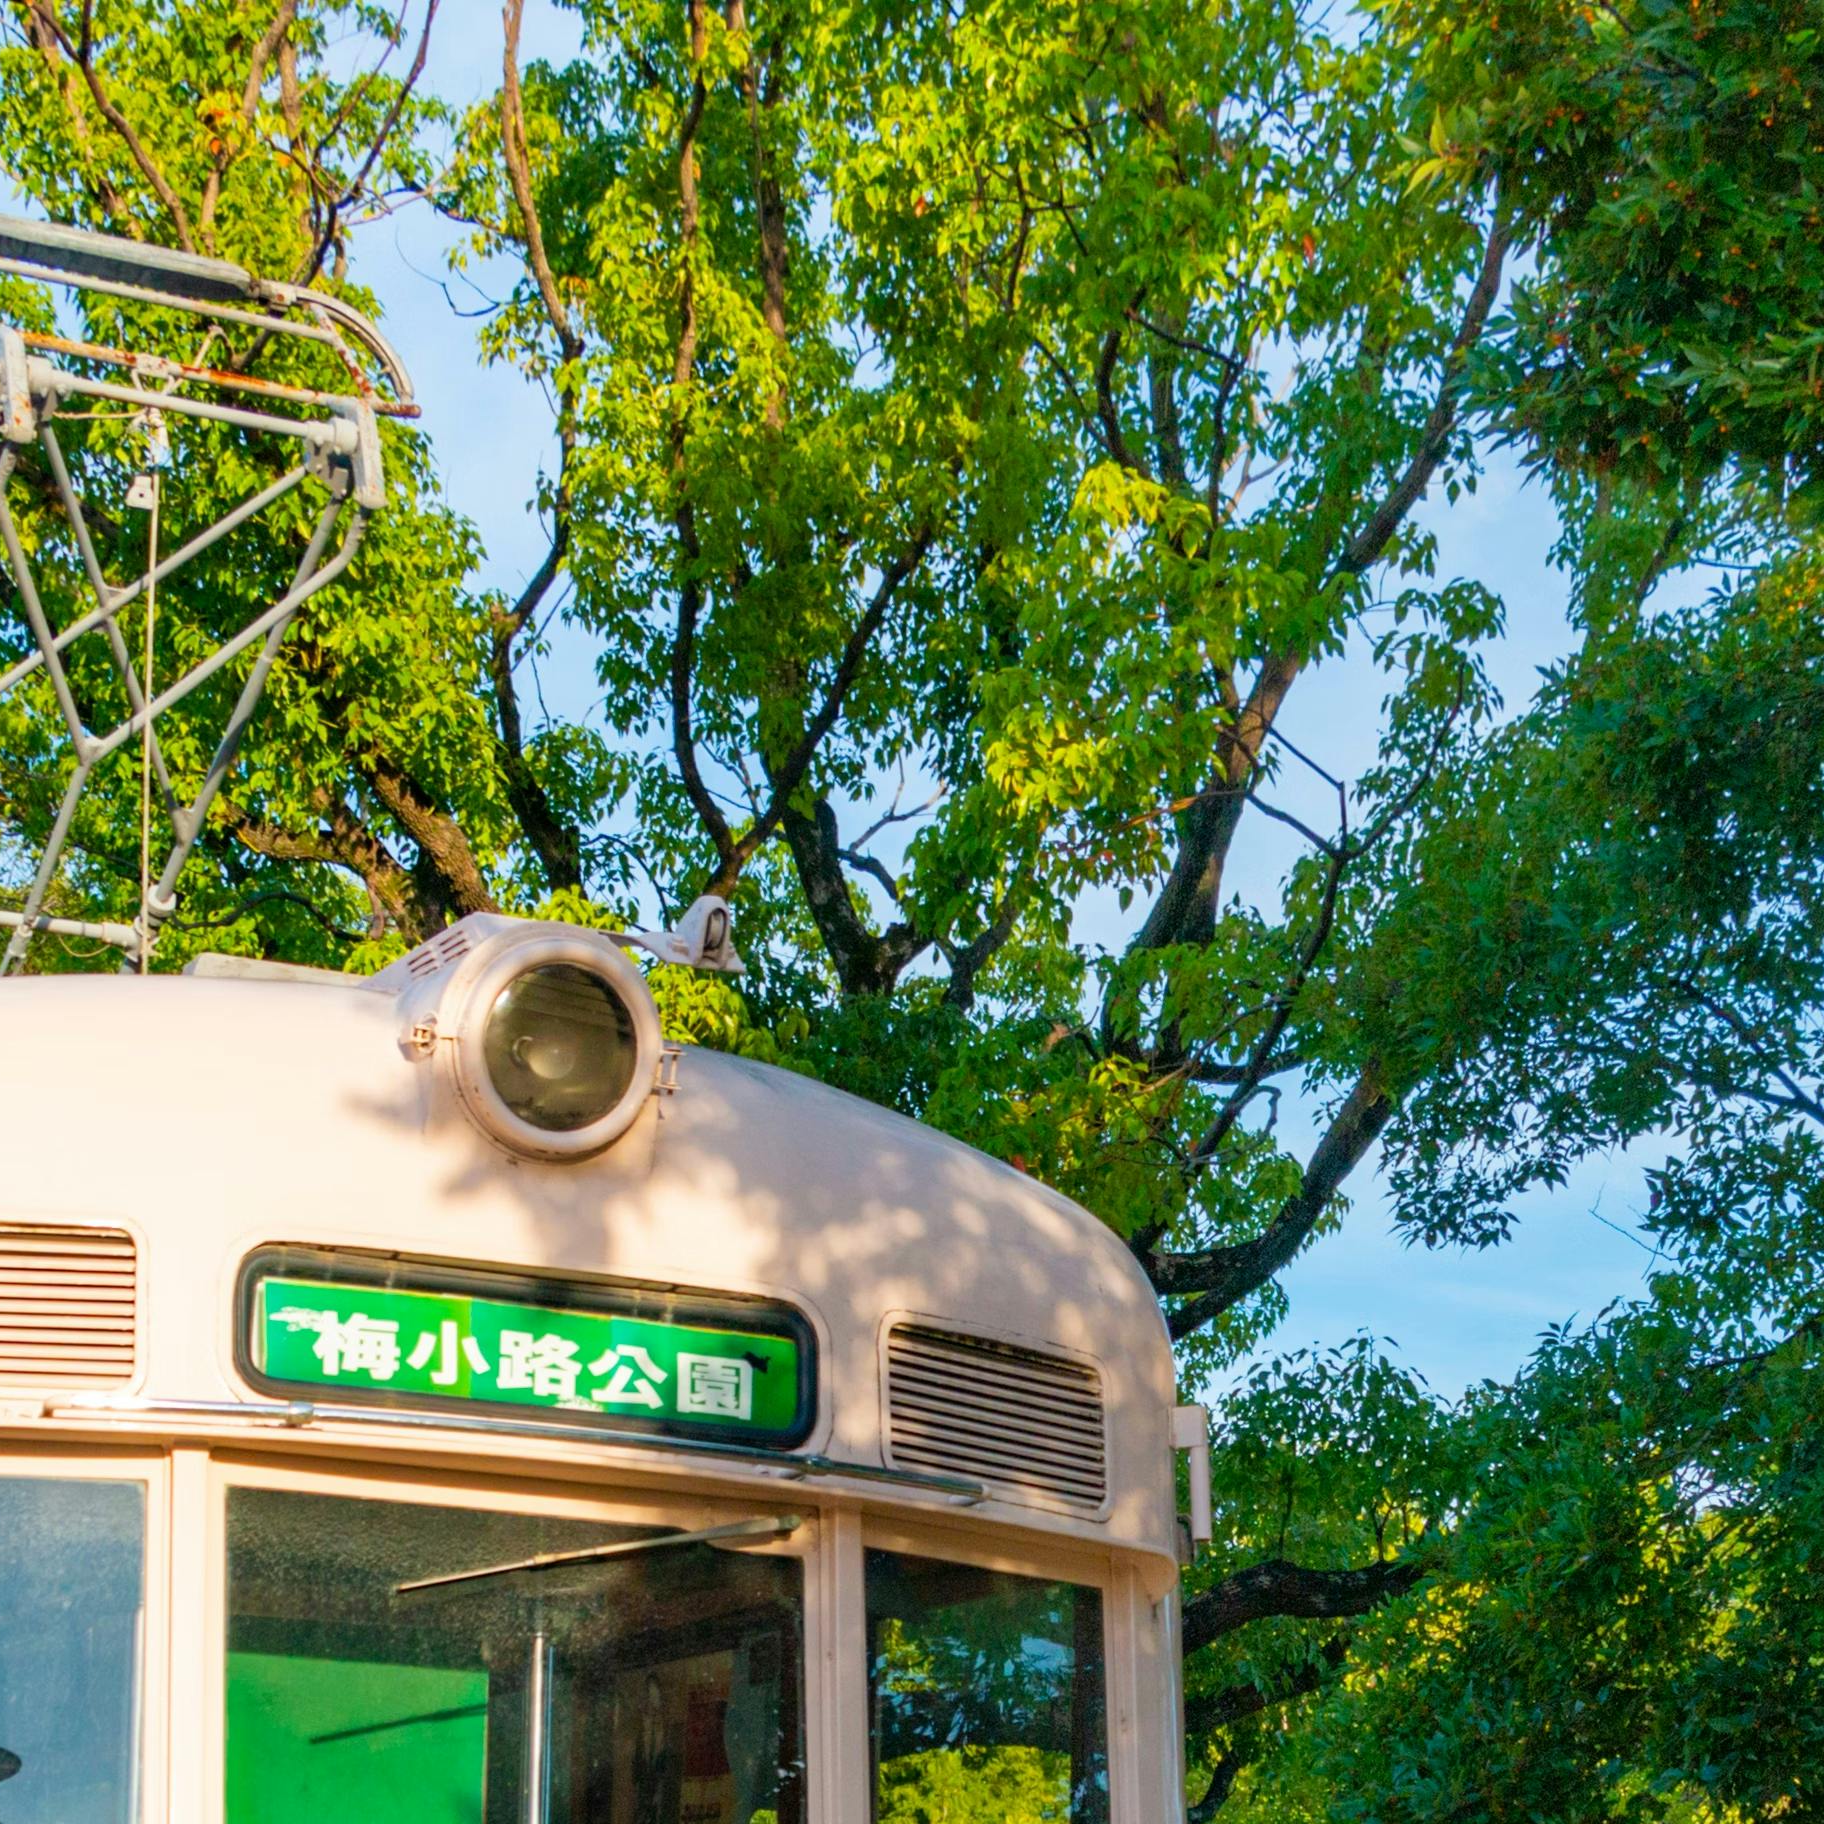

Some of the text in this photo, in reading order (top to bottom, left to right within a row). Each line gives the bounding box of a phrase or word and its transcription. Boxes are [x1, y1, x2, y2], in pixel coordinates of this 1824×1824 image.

[312, 1310, 754, 1421] 梅小路公園
